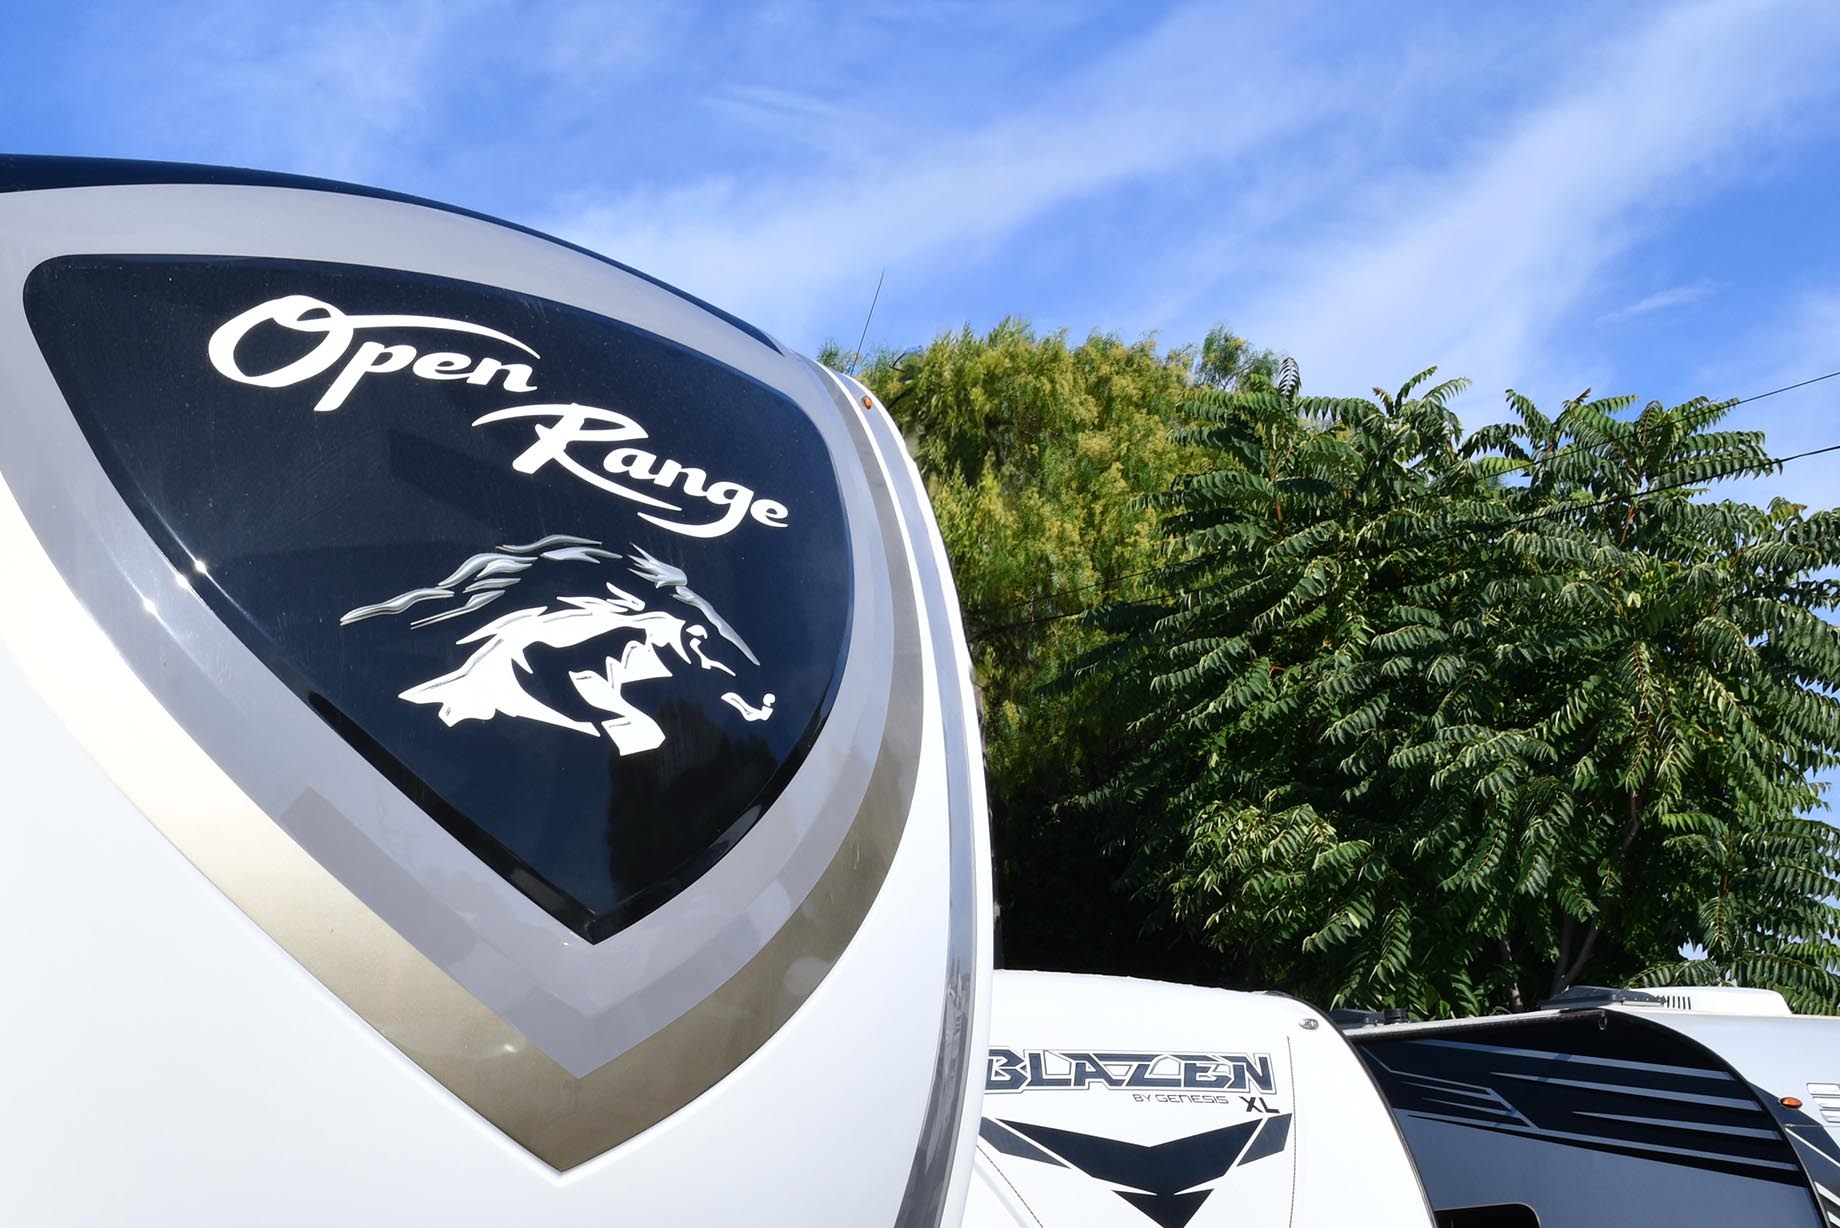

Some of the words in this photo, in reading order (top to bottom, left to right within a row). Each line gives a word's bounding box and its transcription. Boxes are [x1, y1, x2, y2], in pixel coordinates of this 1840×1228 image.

[209, 294, 541, 412] Open
[472, 403, 789, 538] Range
[985, 1047, 1277, 1094] BLAZEN
[1133, 1093, 1151, 1103] BY
[1158, 1094, 1230, 1105] GENESIS
[1239, 1096, 1280, 1114] XL
